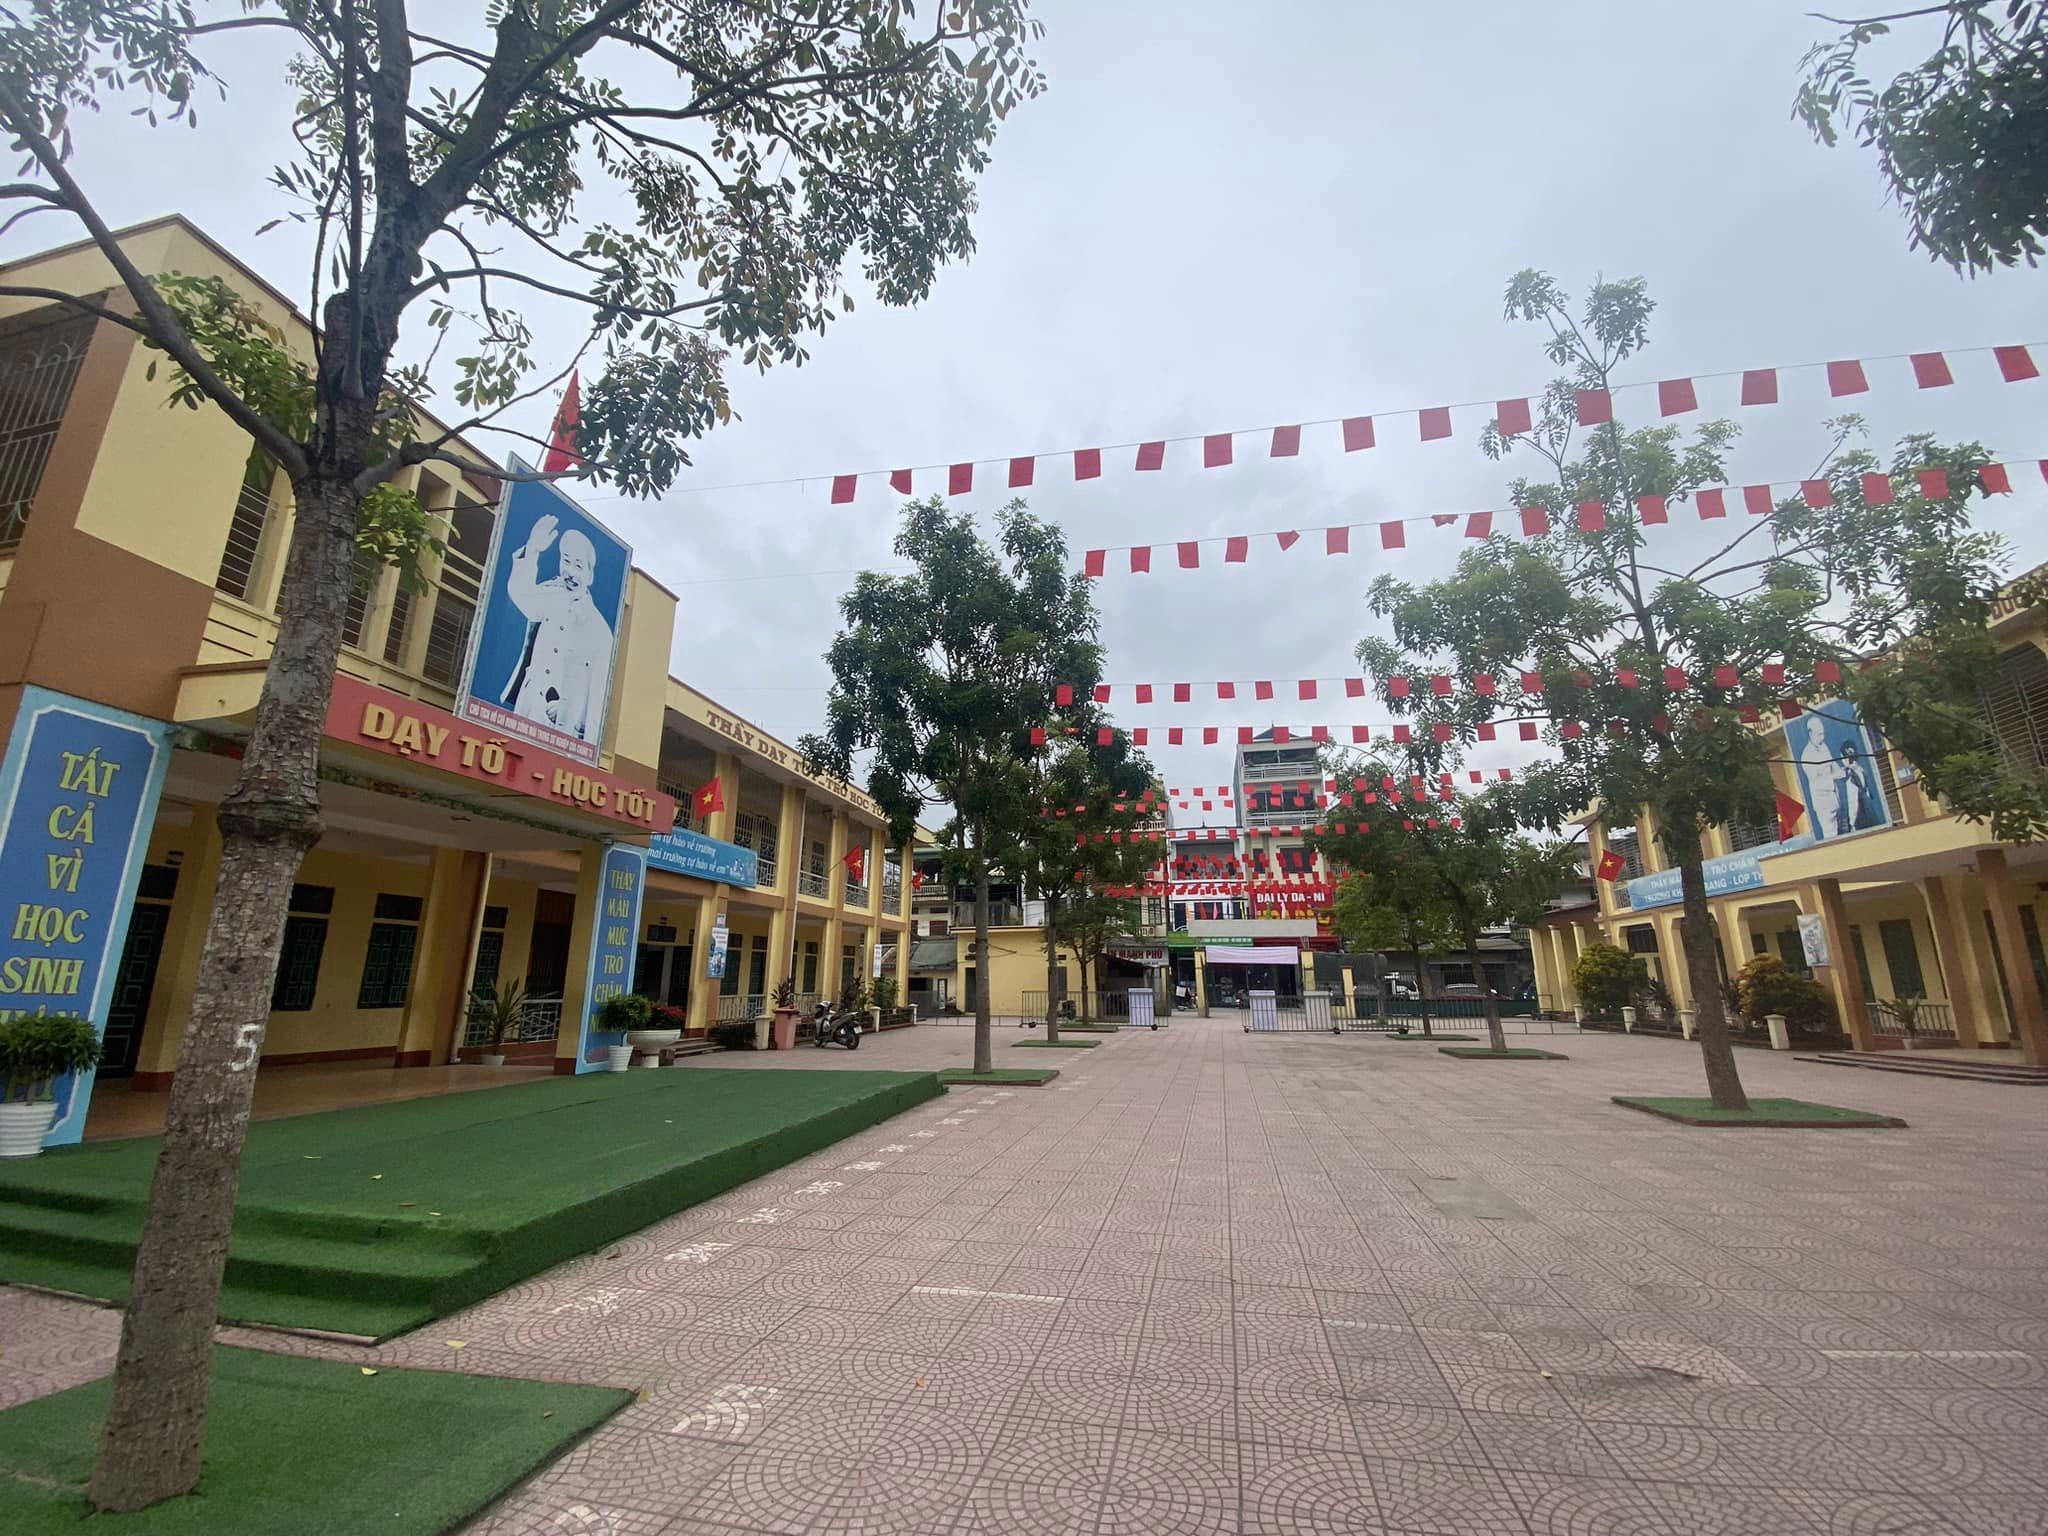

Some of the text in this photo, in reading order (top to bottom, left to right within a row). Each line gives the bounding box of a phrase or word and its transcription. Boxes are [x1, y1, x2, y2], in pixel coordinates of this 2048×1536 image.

[59, 745, 121, 798] TẤT
[360, 702, 450, 756] DẠY
[552, 767, 608, 808] HỌC
[613, 788, 657, 823] TỐT
[47, 800, 95, 845] CẢ
[47, 848, 84, 893] VÌ
[12, 903, 89, 948] HỌC
[0, 956, 85, 995] SINH
[229, 1022, 260, 1072] 5
